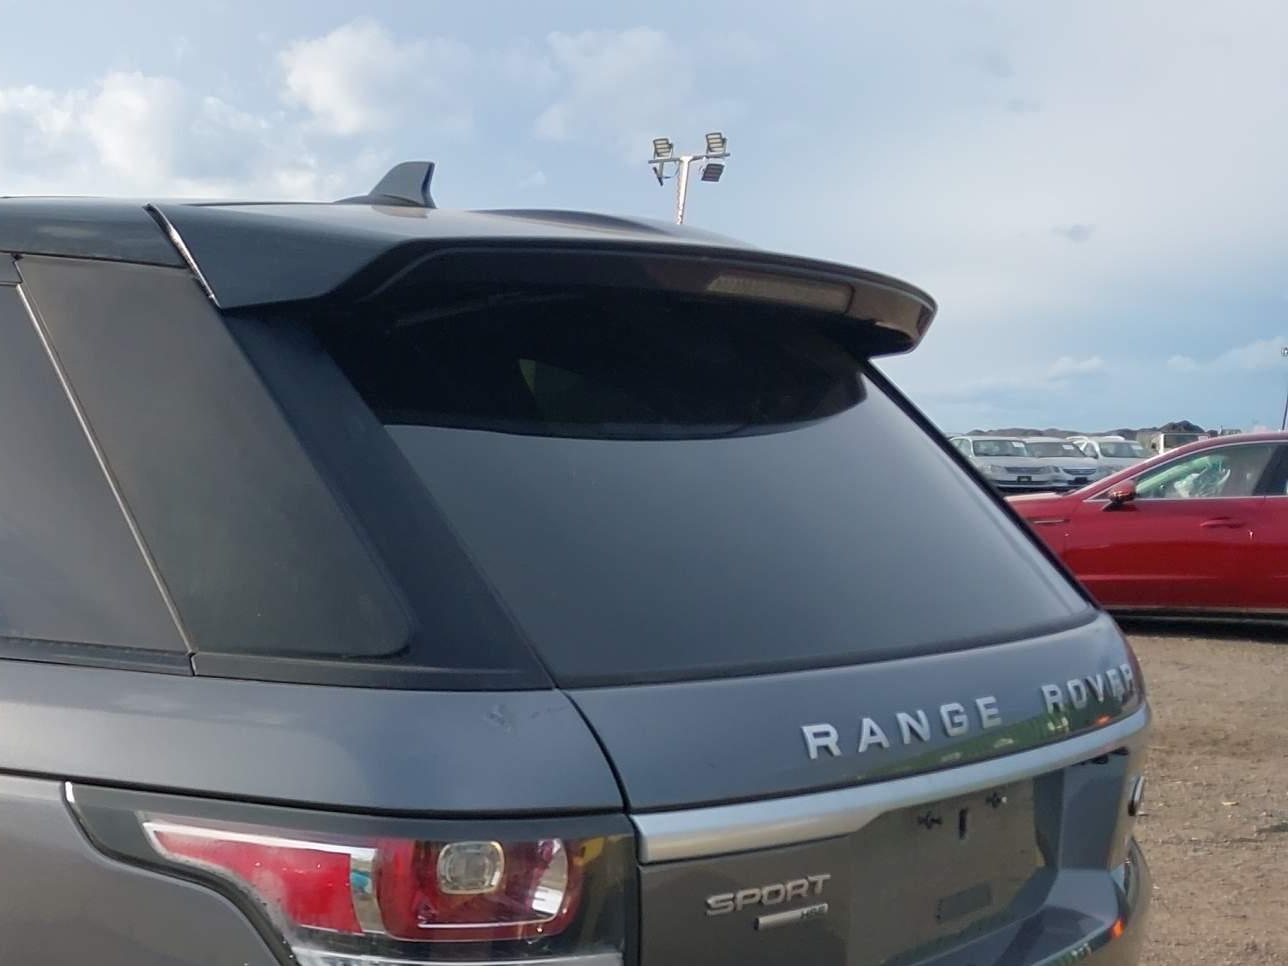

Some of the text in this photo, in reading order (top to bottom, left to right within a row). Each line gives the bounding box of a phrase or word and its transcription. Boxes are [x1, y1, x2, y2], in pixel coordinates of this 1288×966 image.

[800, 663, 1135, 760] RANGE ROVER
[705, 872, 832, 916] SPORT
